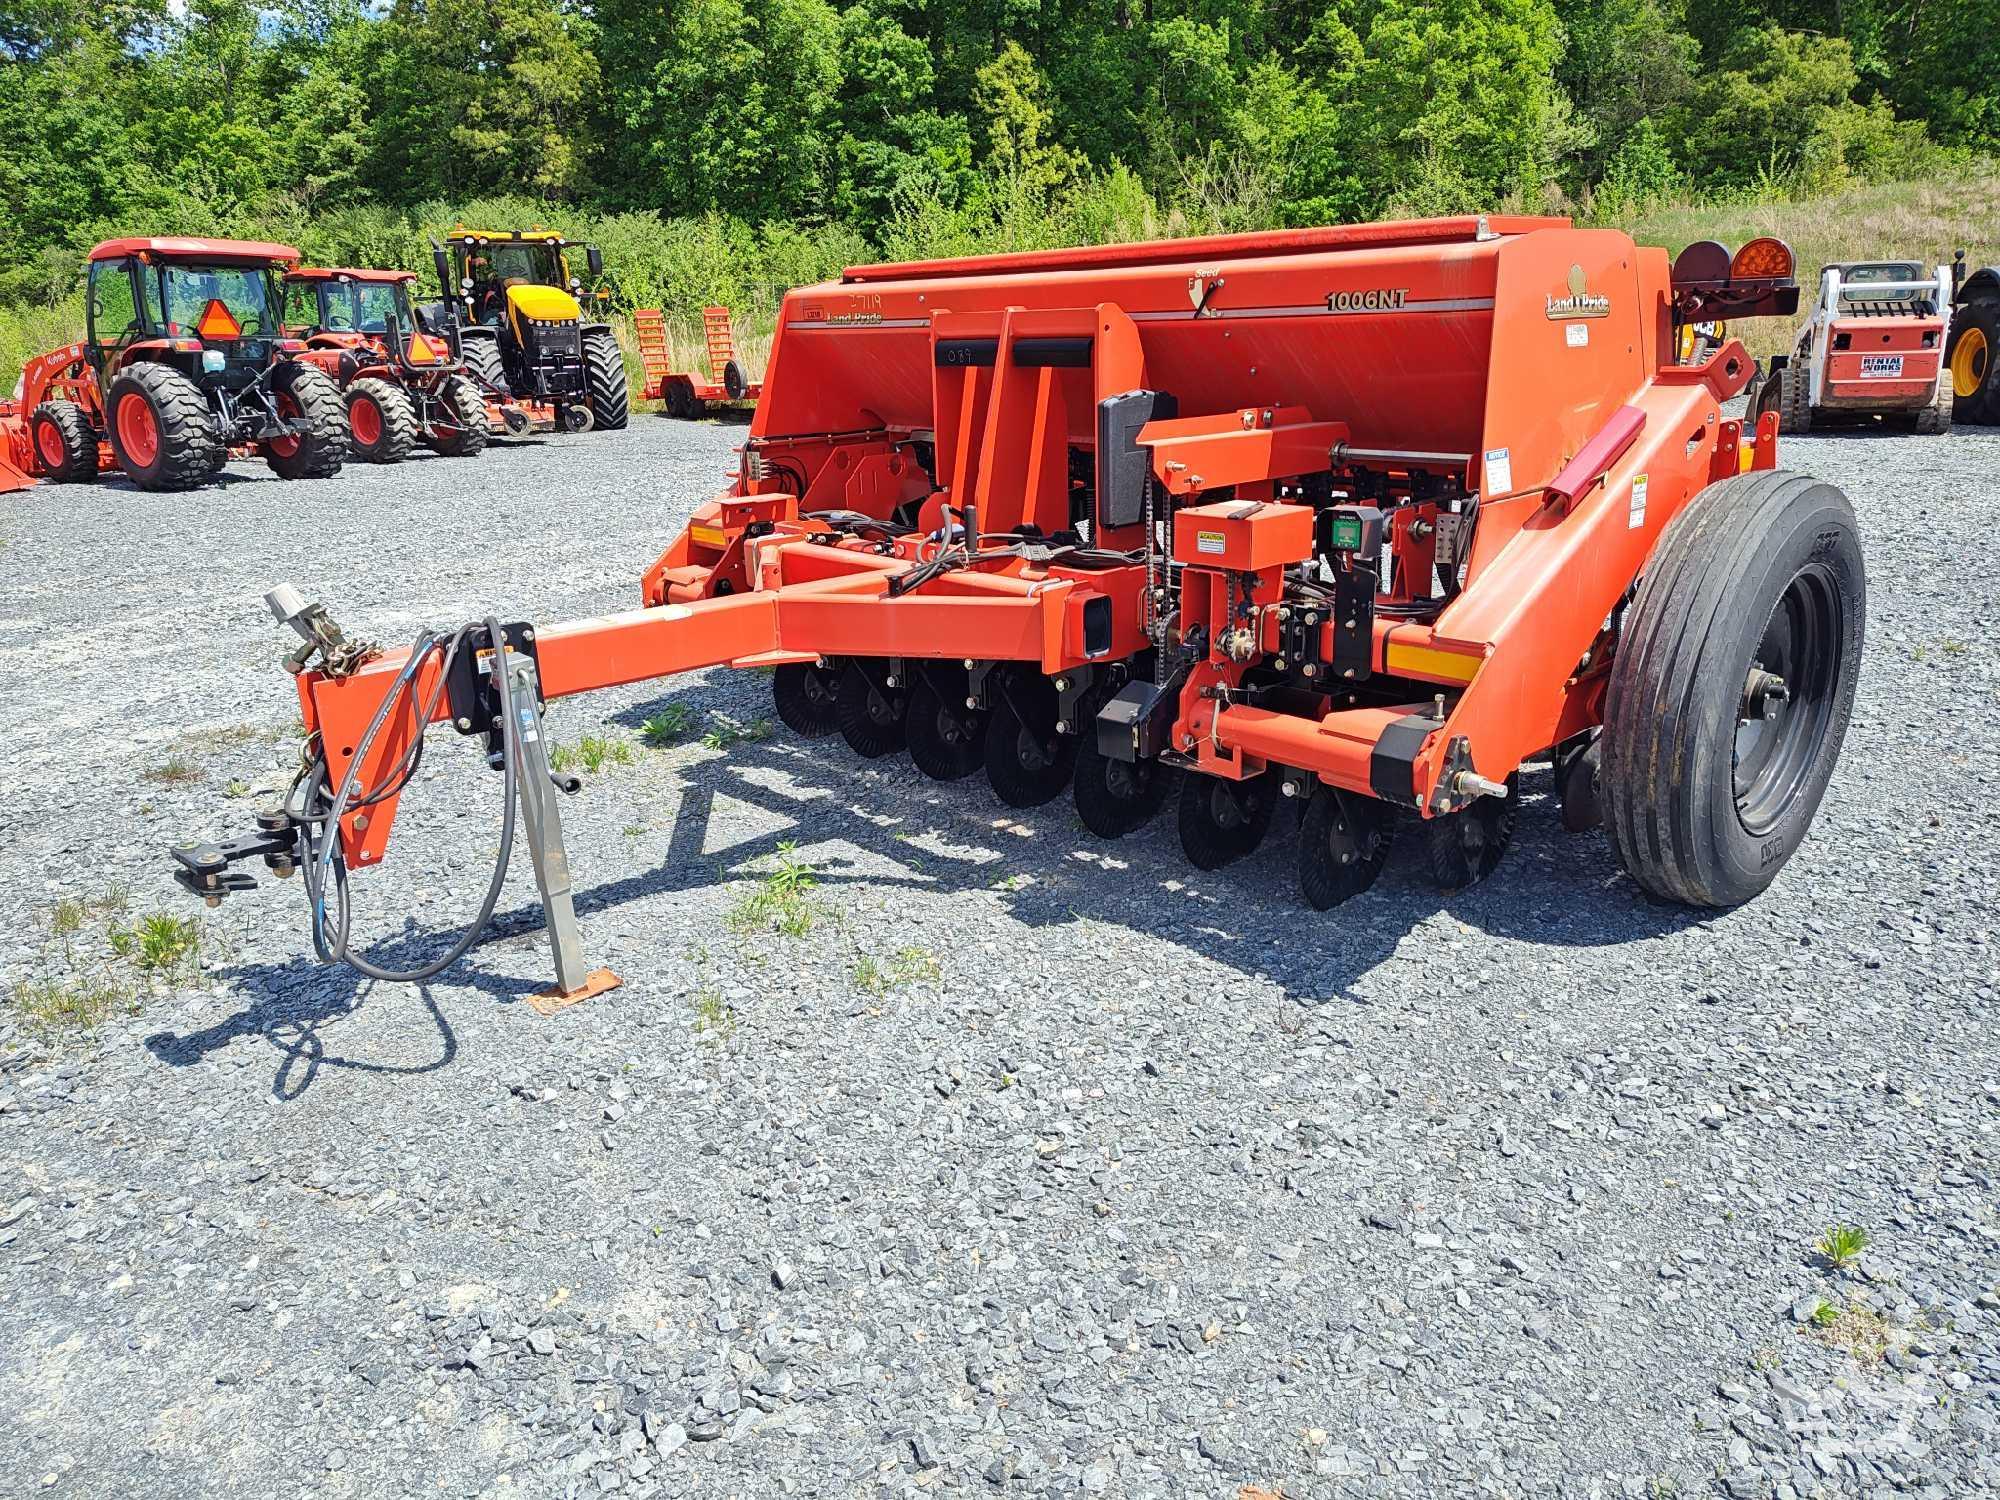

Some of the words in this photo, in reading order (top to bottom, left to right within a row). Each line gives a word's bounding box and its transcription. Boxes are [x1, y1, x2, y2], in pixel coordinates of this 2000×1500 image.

[1326, 288, 1410, 311] 1006NT
[1546, 293, 1575, 313] Land
[1581, 293, 1609, 313] Pride
[826, 312, 852, 325] Land
[853, 311, 882, 325] Pride
[1863, 357, 1901, 365] RENTAL
